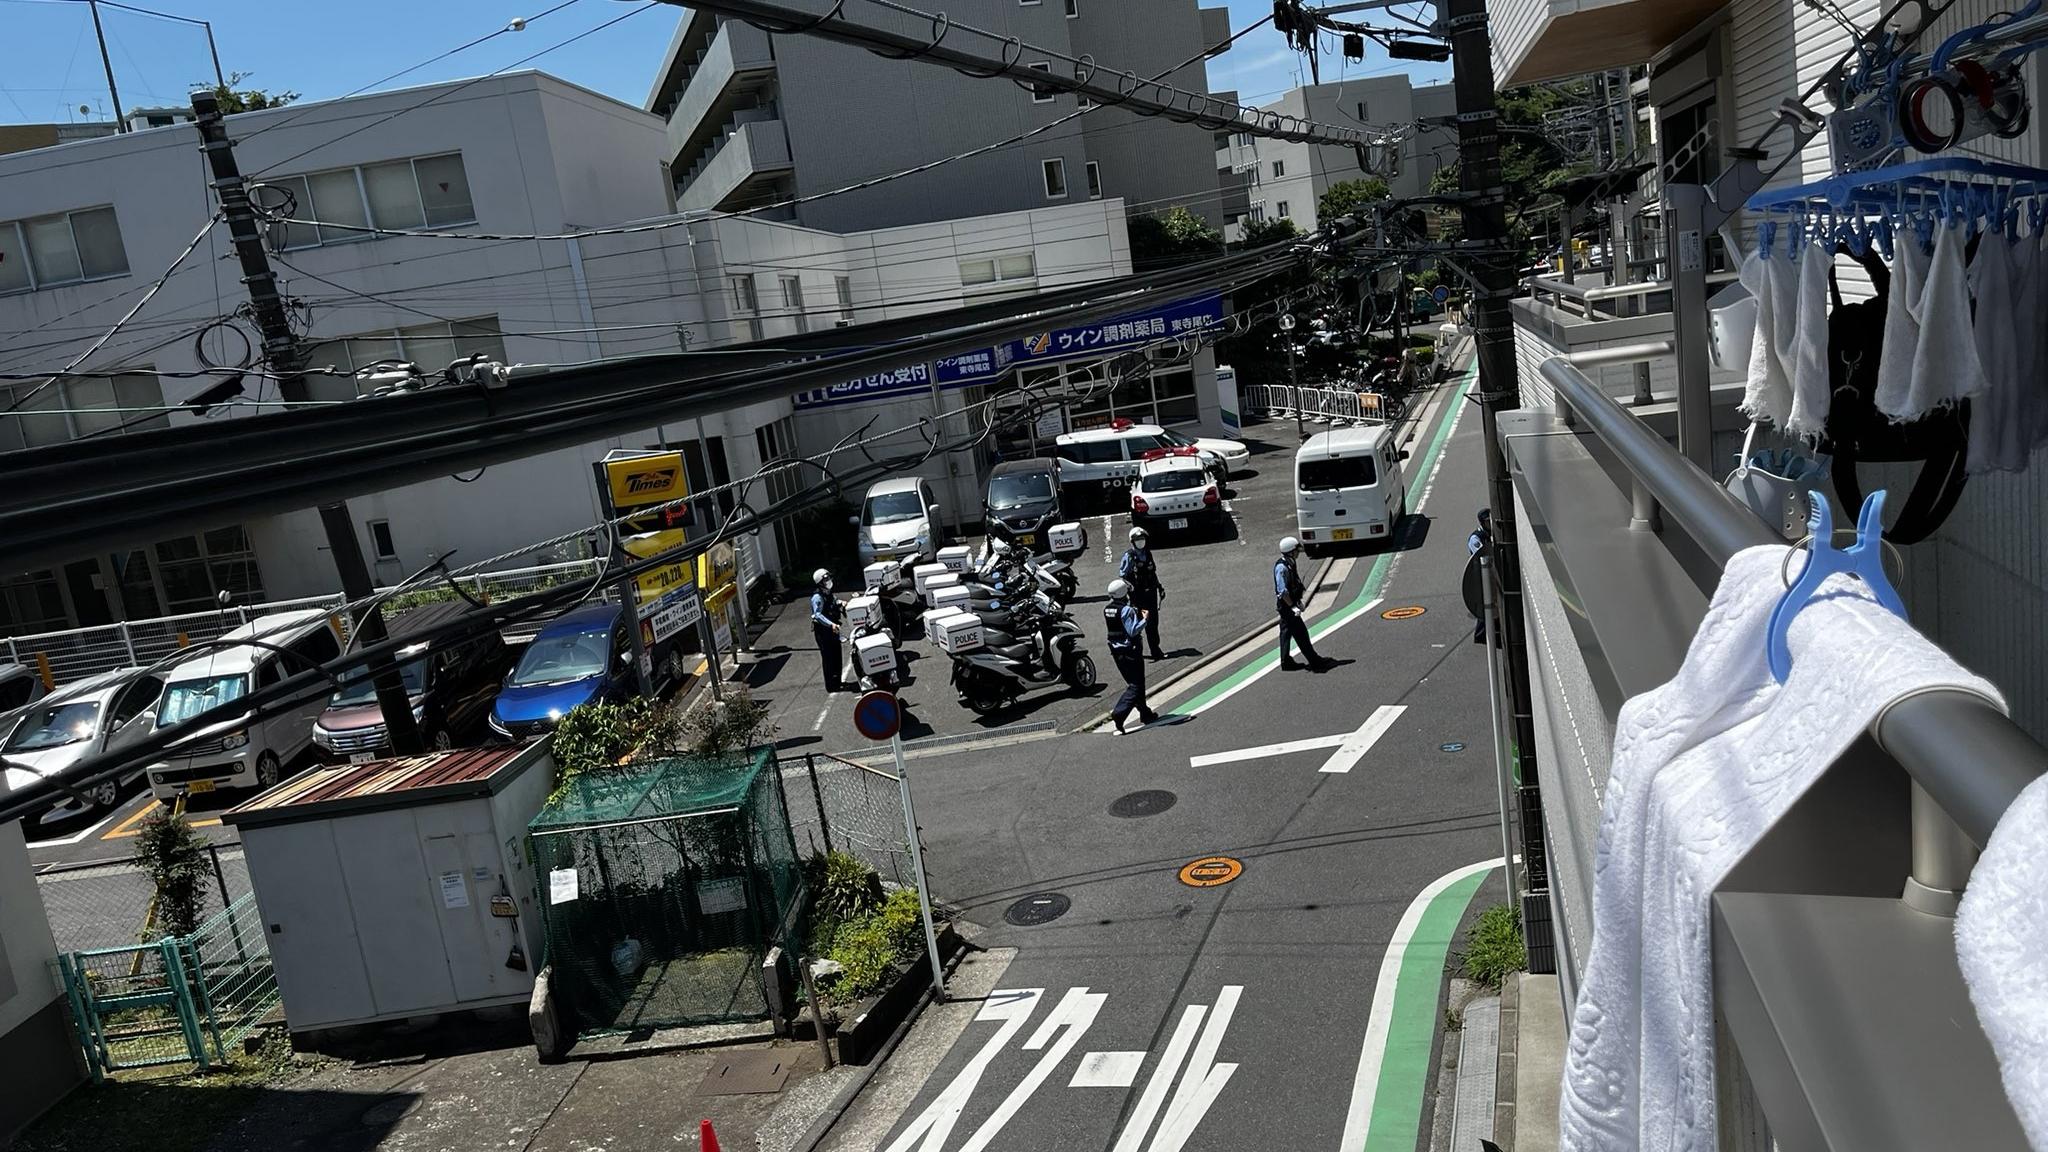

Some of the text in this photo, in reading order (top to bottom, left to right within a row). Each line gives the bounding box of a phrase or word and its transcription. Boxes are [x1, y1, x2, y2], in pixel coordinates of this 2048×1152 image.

[1058, 317, 1166, 350] ウイン調剤薬局
[628, 478, 671, 493] Times
[1054, 537, 1073, 546] POLICE
[955, 632, 978, 645] POLICE
